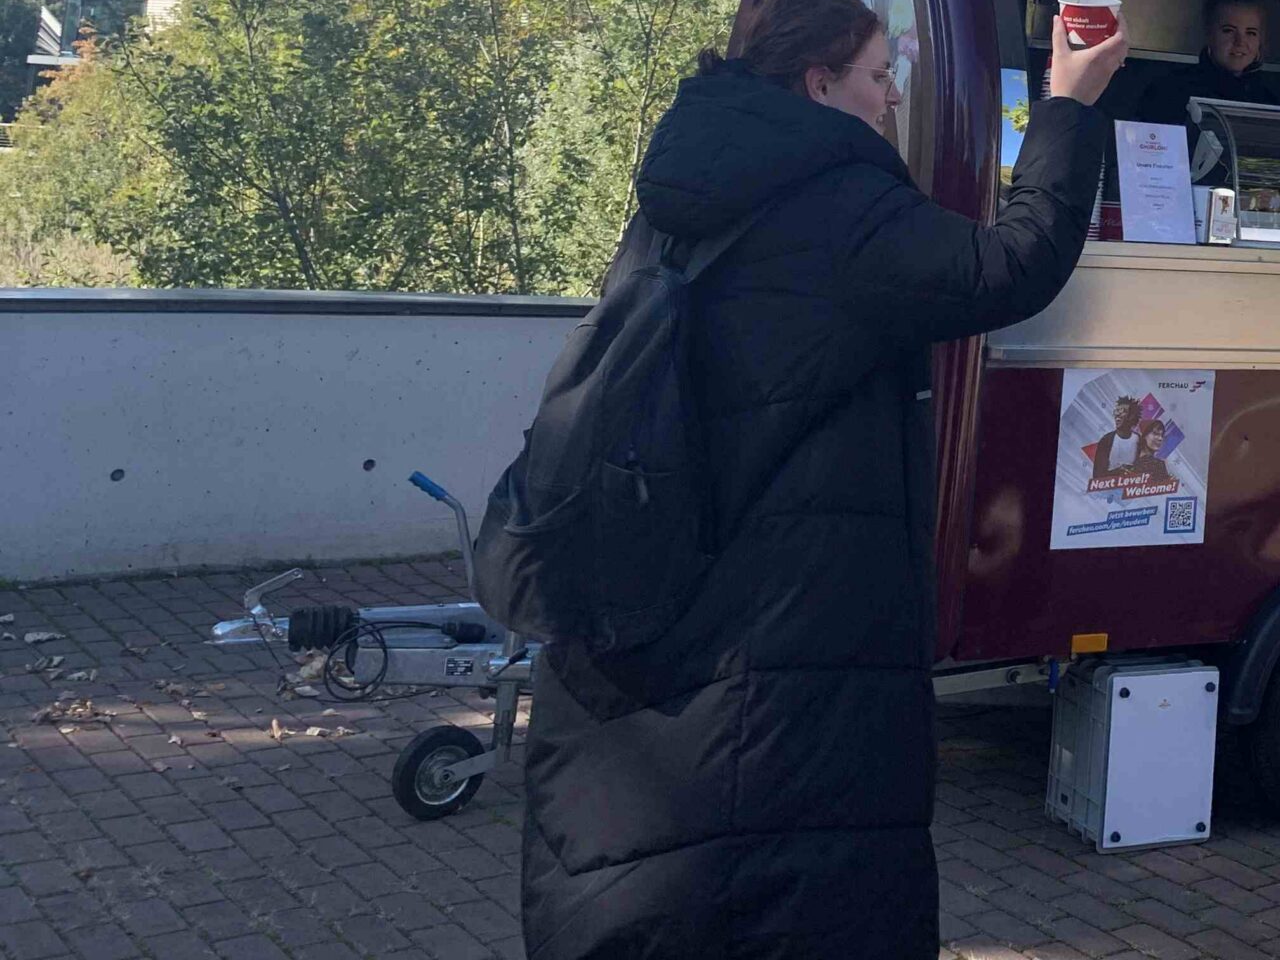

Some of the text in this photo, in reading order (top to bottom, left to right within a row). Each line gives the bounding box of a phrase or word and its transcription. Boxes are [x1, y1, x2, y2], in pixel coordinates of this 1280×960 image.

[1089, 473, 1150, 490] Next Level?
[1125, 481, 1176, 497] Welcome!
